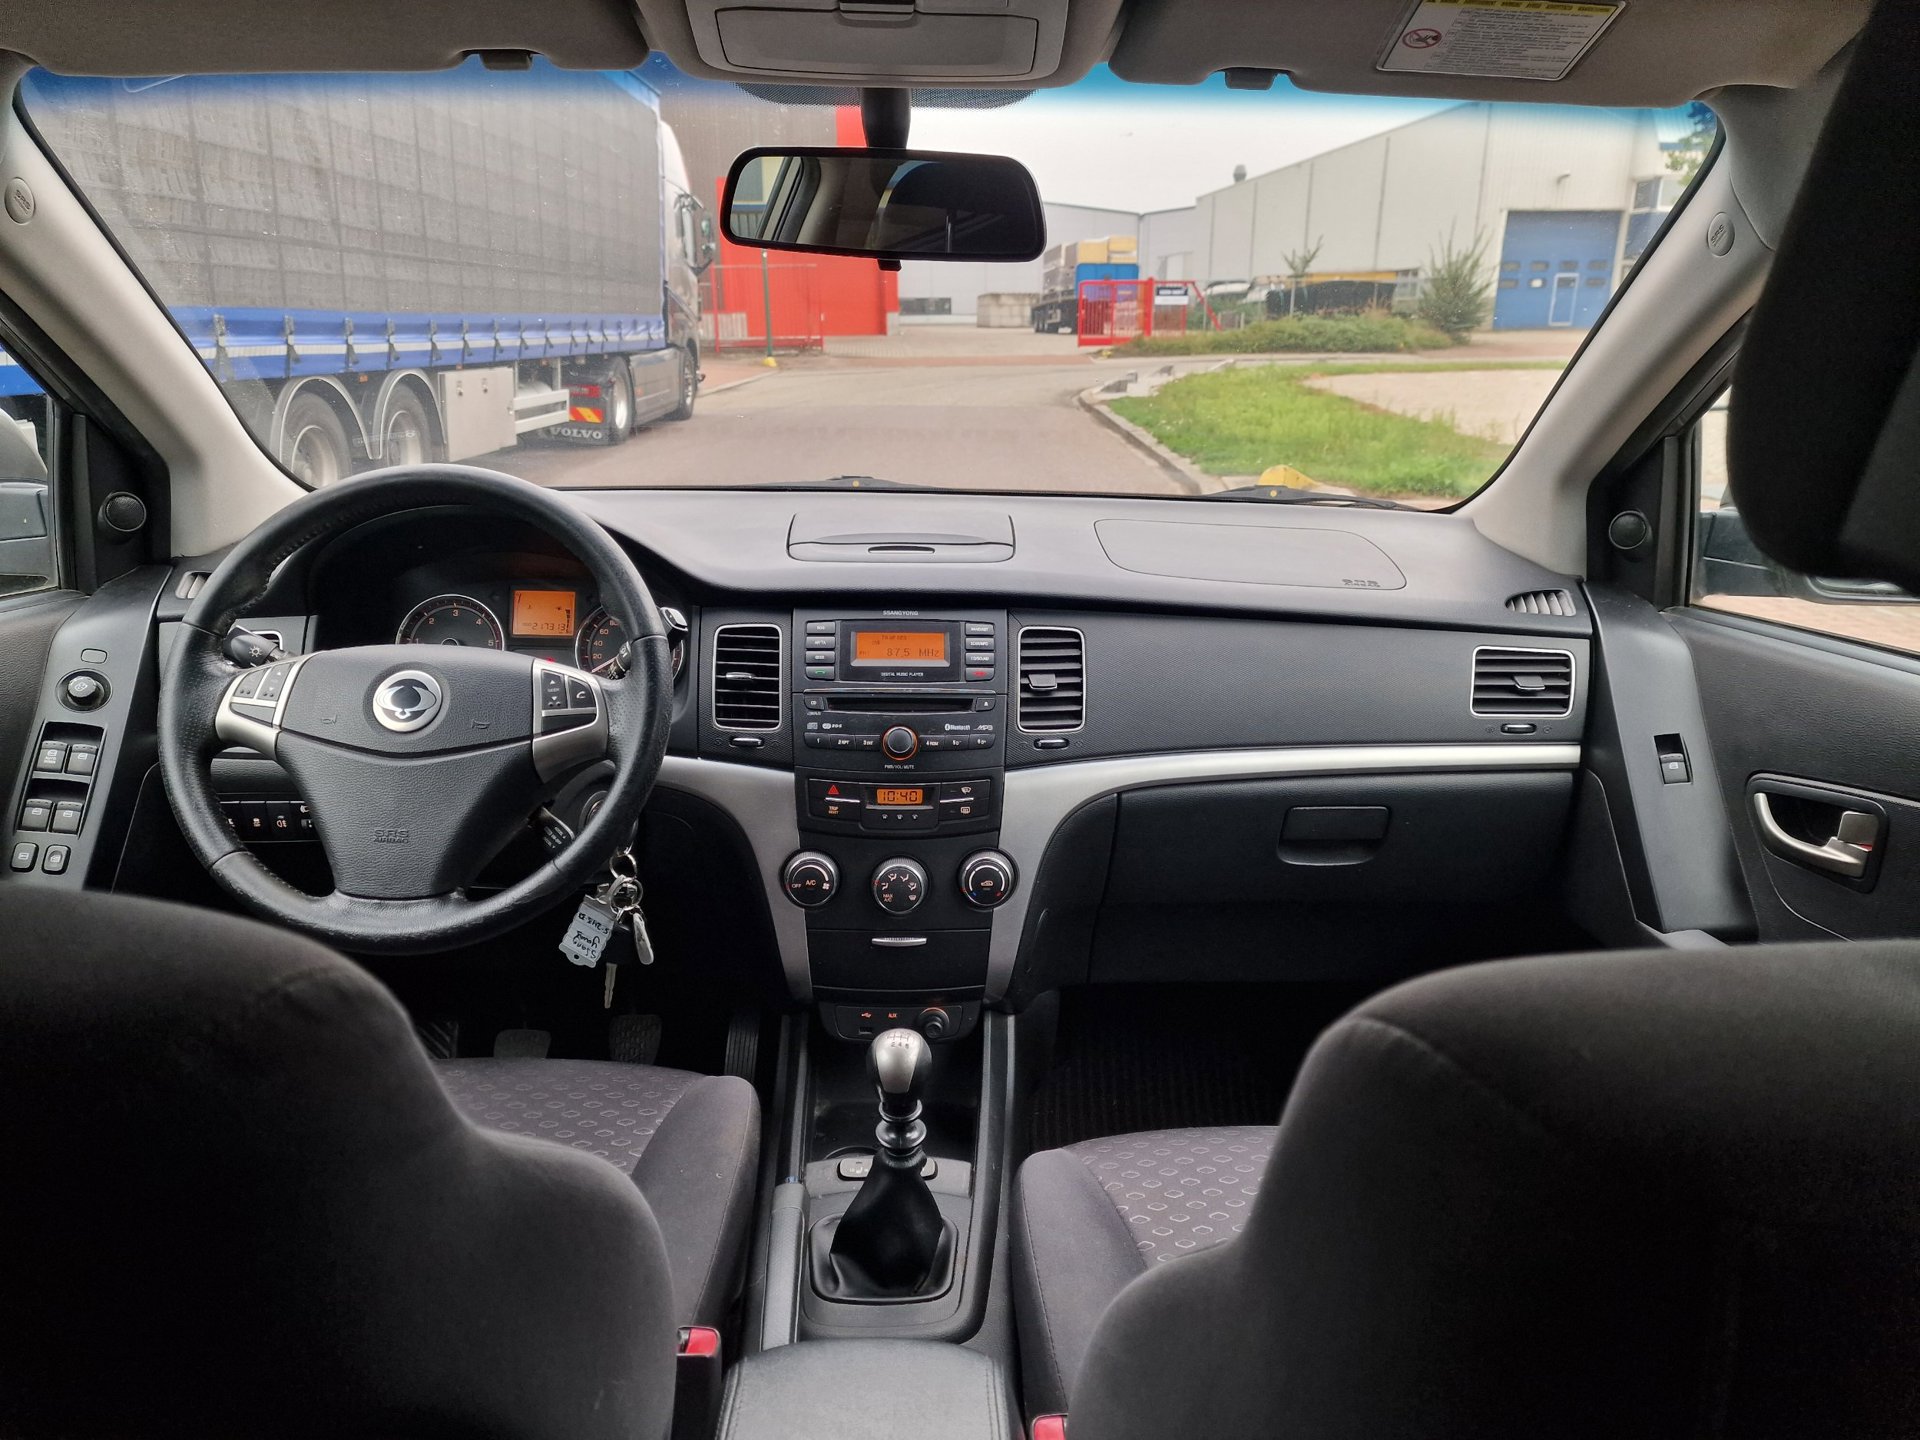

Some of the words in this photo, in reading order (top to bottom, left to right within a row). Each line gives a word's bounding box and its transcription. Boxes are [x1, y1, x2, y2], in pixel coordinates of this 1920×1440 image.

[551, 427, 602, 440] VOLVO
[452, 609, 459, 617] 3
[428, 617, 435, 625] 2
[487, 639, 494, 647] 5
[886, 647, 911, 658] 87.5
[919, 647, 940, 658] MHz
[883, 790, 918, 802] 10:40
[805, 878, 817, 886] A/C
